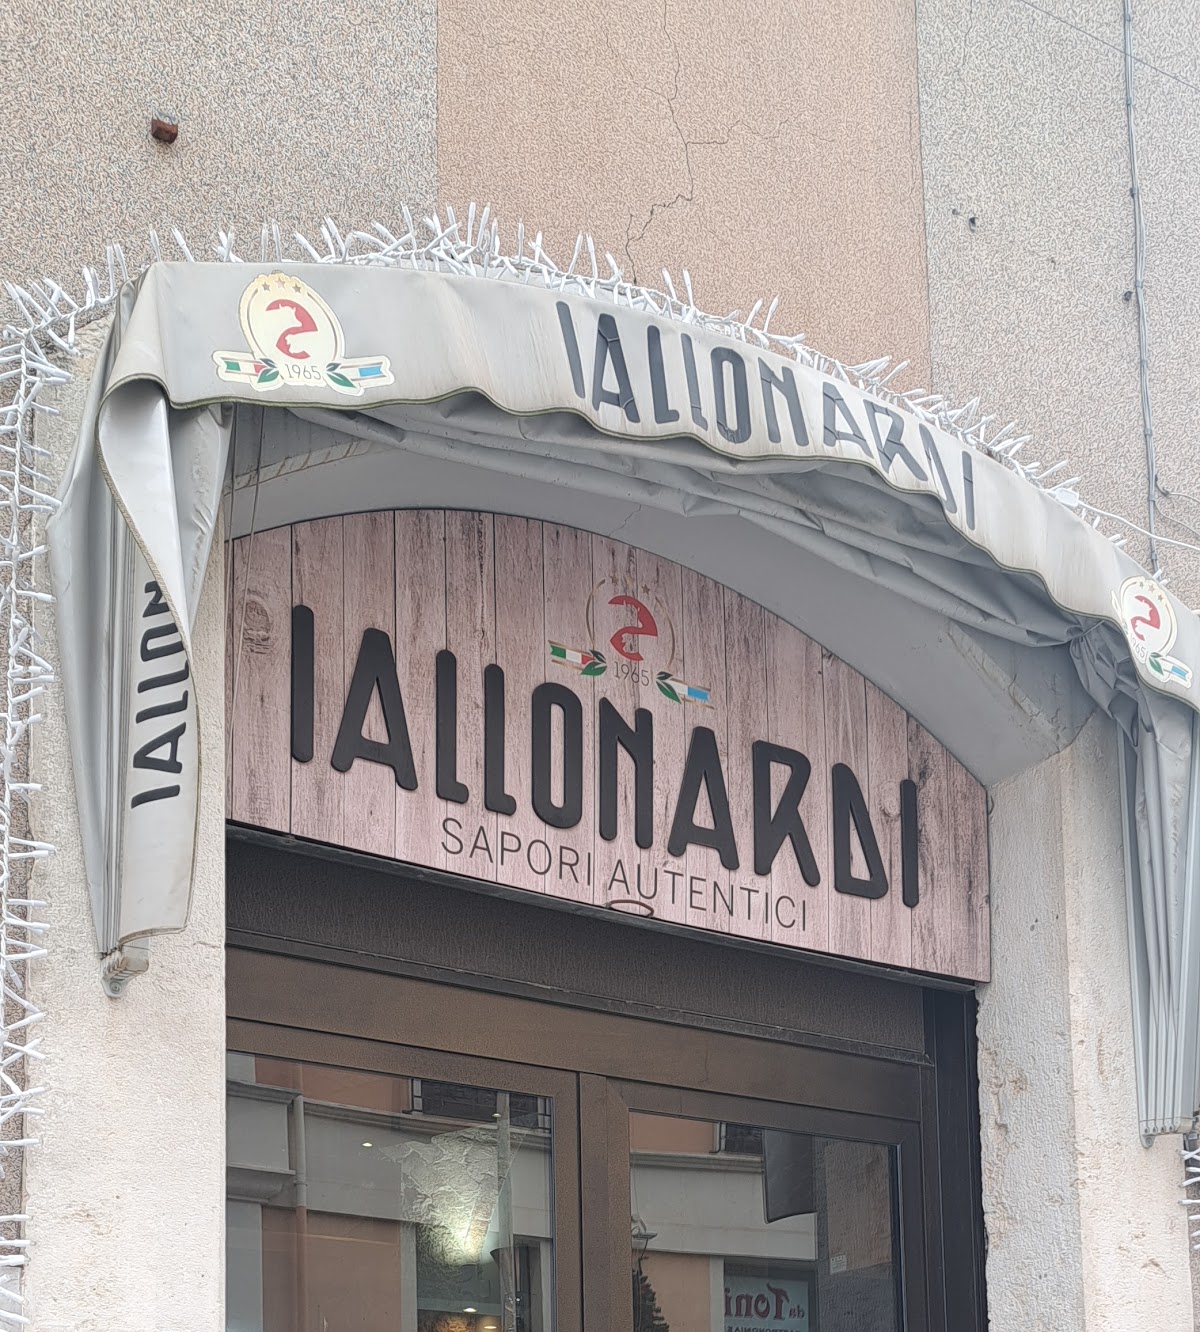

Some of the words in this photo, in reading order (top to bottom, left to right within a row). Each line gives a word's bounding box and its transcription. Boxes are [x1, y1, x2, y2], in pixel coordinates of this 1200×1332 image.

[285, 363, 321, 380] 1965
[555, 300, 976, 530] IALLONARDI
[614, 661, 649, 686] 1965
[290, 604, 918, 908] IALLONARDI
[441, 818, 591, 886] SAPORI
[608, 858, 806, 931] AUTENTICI
